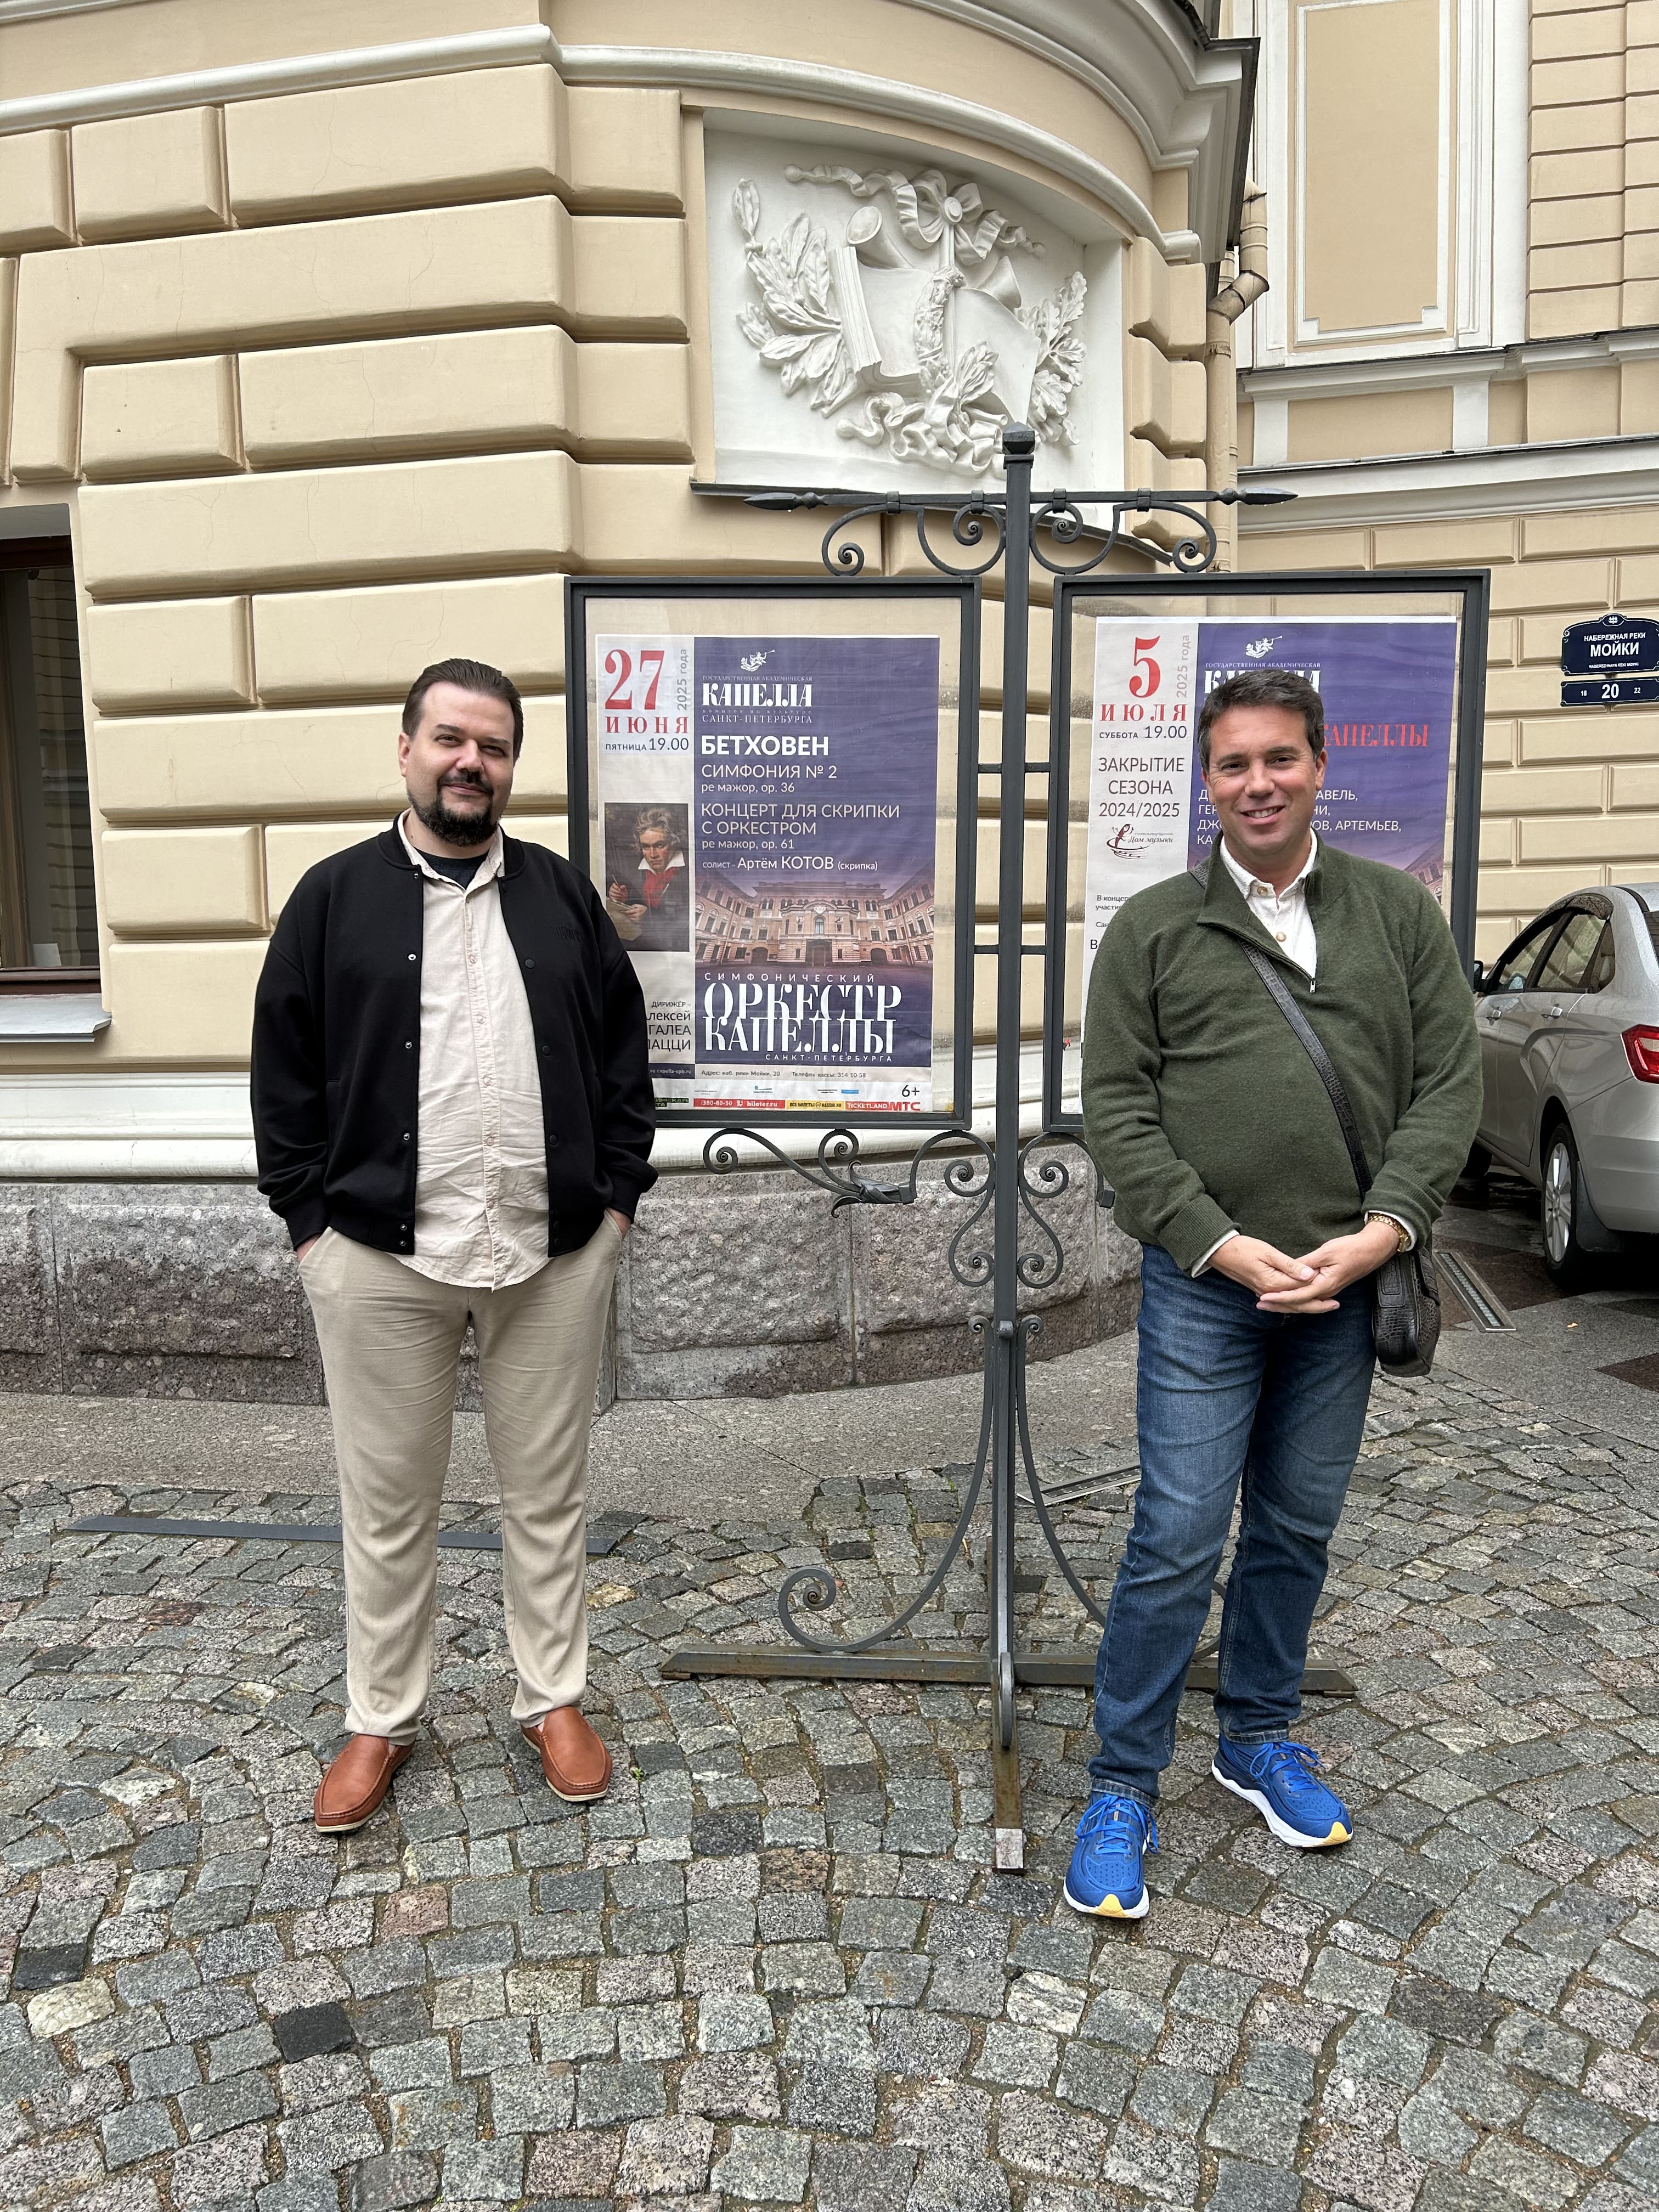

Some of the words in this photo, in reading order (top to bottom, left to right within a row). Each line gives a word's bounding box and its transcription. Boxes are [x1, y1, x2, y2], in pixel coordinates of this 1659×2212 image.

[1584, 633, 1628, 642] НАБЕРЕЖНАЯ
[1590, 640, 1639, 657] МОЙКИ
[680, 649, 689, 674] года
[1128, 635, 1161, 698] 5
[1176, 665, 1188, 698] 2025
[1182, 635, 1191, 661] года
[605, 649, 664, 710] 27
[677, 679, 687, 710] 2025
[702, 682, 812, 707] КАПЕЛЛА
[1601, 684, 1619, 699] 20
[702, 715, 812, 723] САНКТ-ПЕТЕРБУРГА
[1099, 704, 1188, 721] ИЮЛЯ
[605, 716, 689, 733] ИЮНЯ
[1144, 725, 1187, 738] 19.00
[649, 738, 689, 751] 19.00
[701, 735, 829, 756] БЕТХОВЕН
[702, 764, 800, 778] СИМФОНИЯ
[828, 765, 838, 778] 2
[1098, 757, 1185, 772] ЗАКРЫТИЕ
[702, 785, 714, 793] ре
[718, 785, 758, 793] мажор,
[781, 782, 795, 793] 36
[1108, 780, 1173, 794] СЕЗОНА
[1315, 790, 1358, 802] АВЕЛЬ,
[702, 803, 778, 819] КОНЦЕРТ
[781, 804, 816, 820] ДЛЯ
[821, 804, 900, 818] СКРИПКИ
[1099, 802, 1180, 817] 2024/2025
[702, 821, 712, 834] С
[716, 821, 816, 836] ОРКЕСТРОМ
[1335, 821, 1402, 833] АРТЕМЬЕВ,
[702, 841, 715, 850] ре
[718, 841, 758, 850] мажор,
[781, 839, 794, 849] 61
[737, 856, 777, 871] Артём
[781, 856, 834, 870] КОТОВ
[838, 861, 878, 871] (скрипка)
[704, 972, 874, 983] СИМФОНИЧЕСКИЙ
[704, 983, 902, 1021] ОРКЕСТР
[646, 1010, 691, 1021] лексей
[702, 1016, 896, 1054] КАПЕЛЛЫ
[765, 1054, 892, 1062] САНКТ-ПЕТЕРБУРГА
[901, 1084, 920, 1098] 6+
